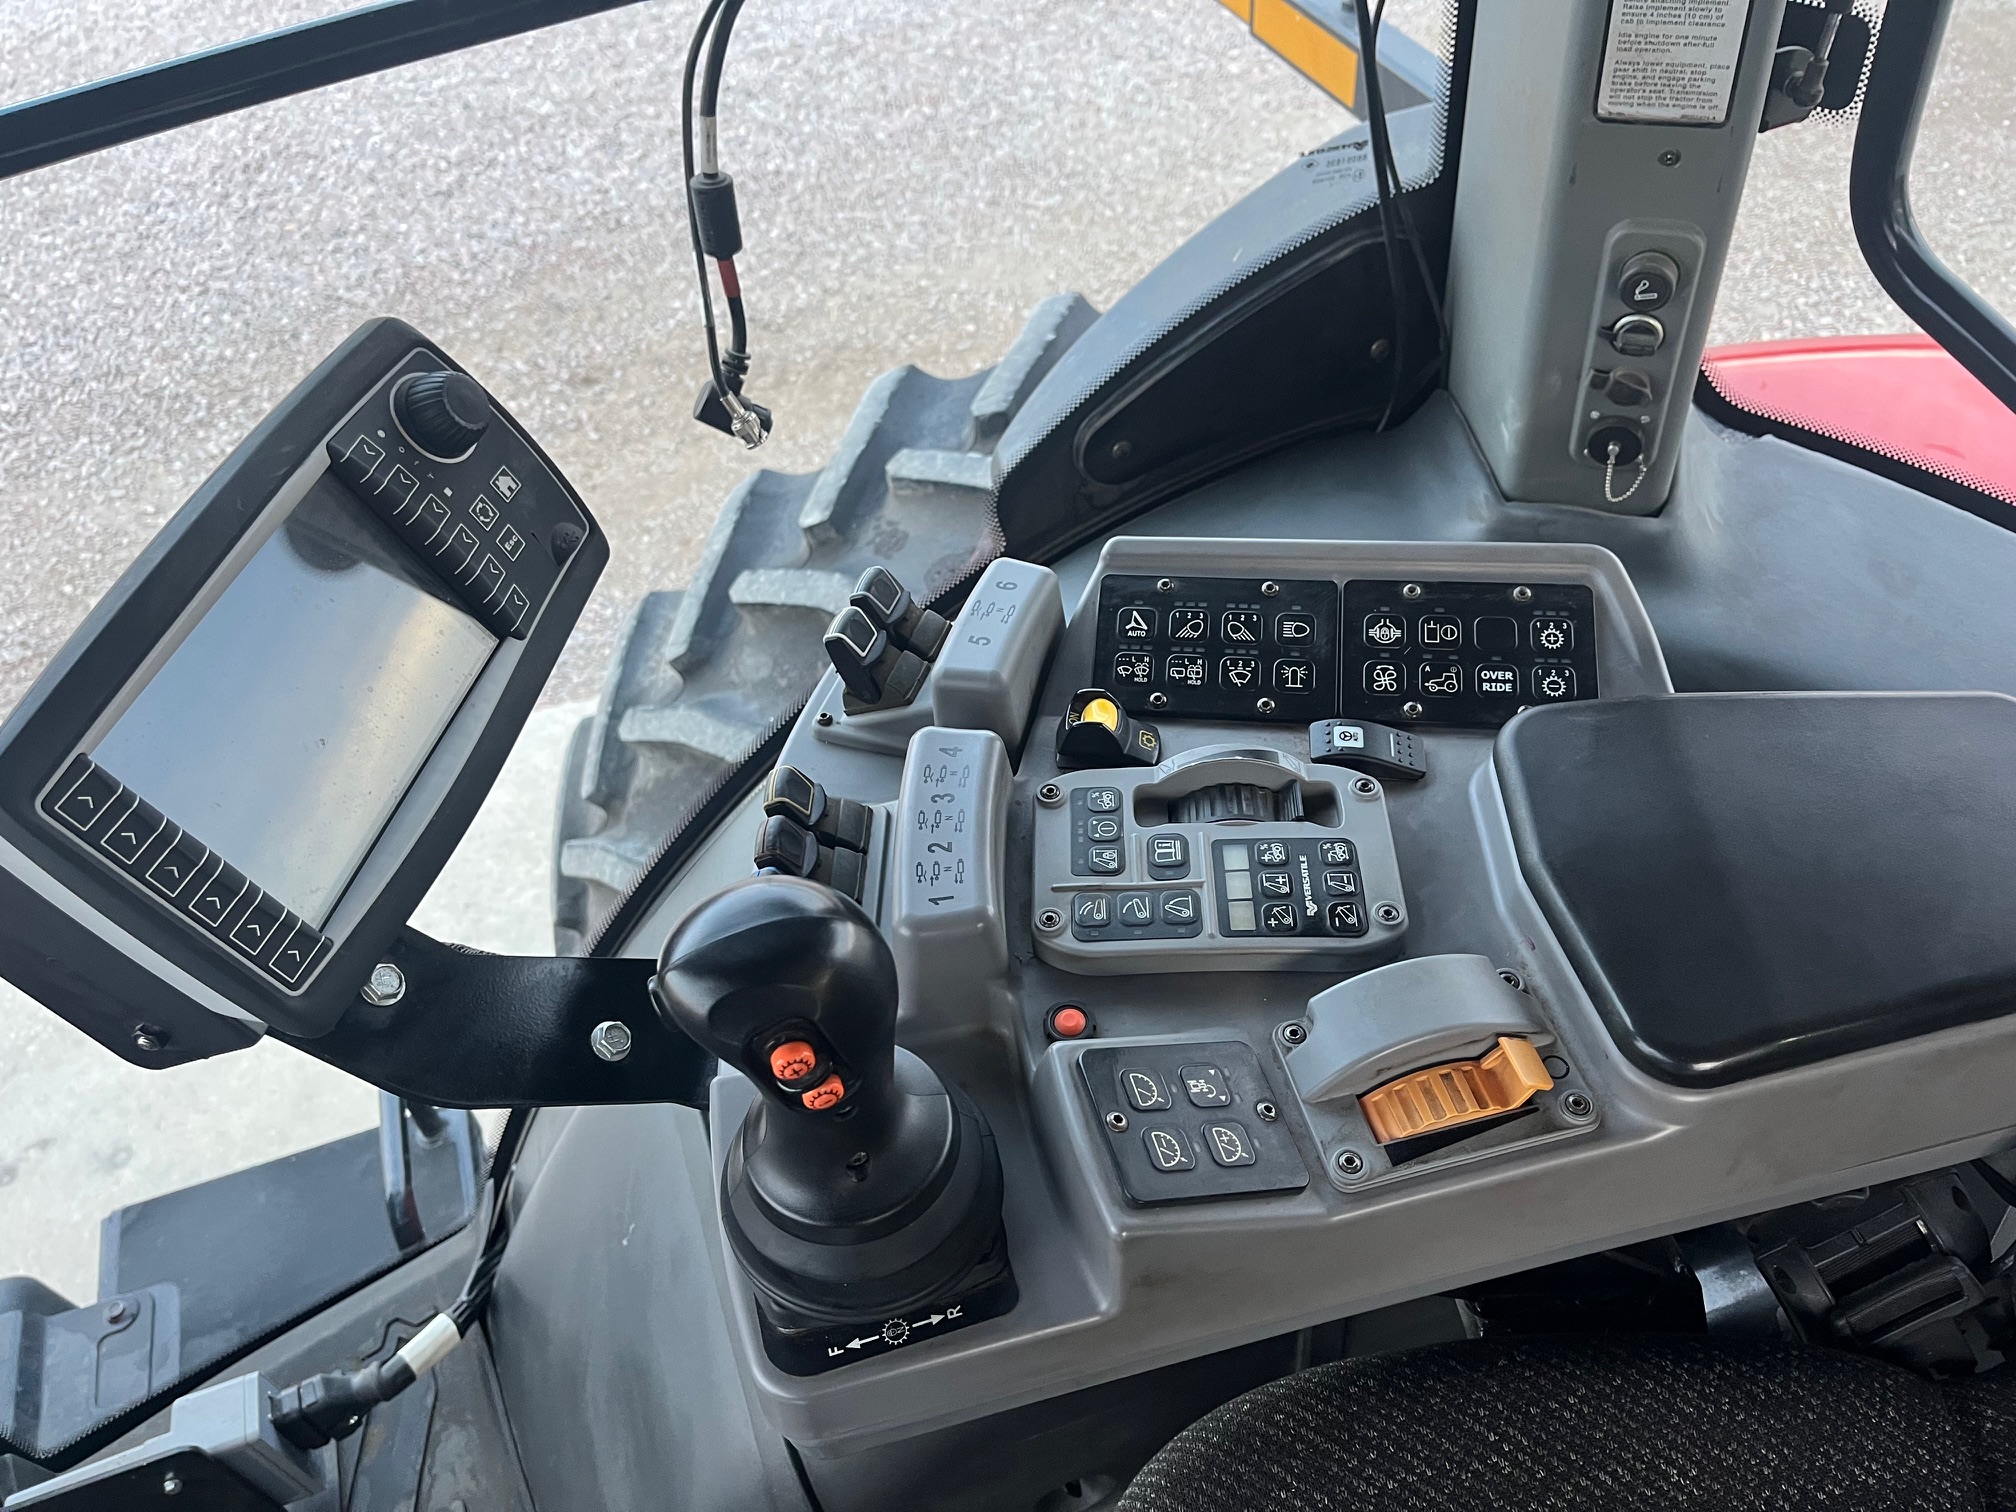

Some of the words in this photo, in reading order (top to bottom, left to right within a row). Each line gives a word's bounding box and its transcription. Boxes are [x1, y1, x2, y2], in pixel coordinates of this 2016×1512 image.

[505, 535, 518, 551] Esc
[996, 581, 1018, 590] 6
[968, 636, 991, 646] 5
[1480, 670, 1514, 680] OVER
[1482, 683, 1513, 692] RIDE
[939, 747, 963, 757] 4
[930, 793, 955, 803] 3
[927, 841, 953, 853] 2
[1299, 855, 1312, 901] VERSATILE
[928, 895, 954, 905] 1
[946, 1304, 963, 1319] R
[827, 1346, 844, 1357] F
